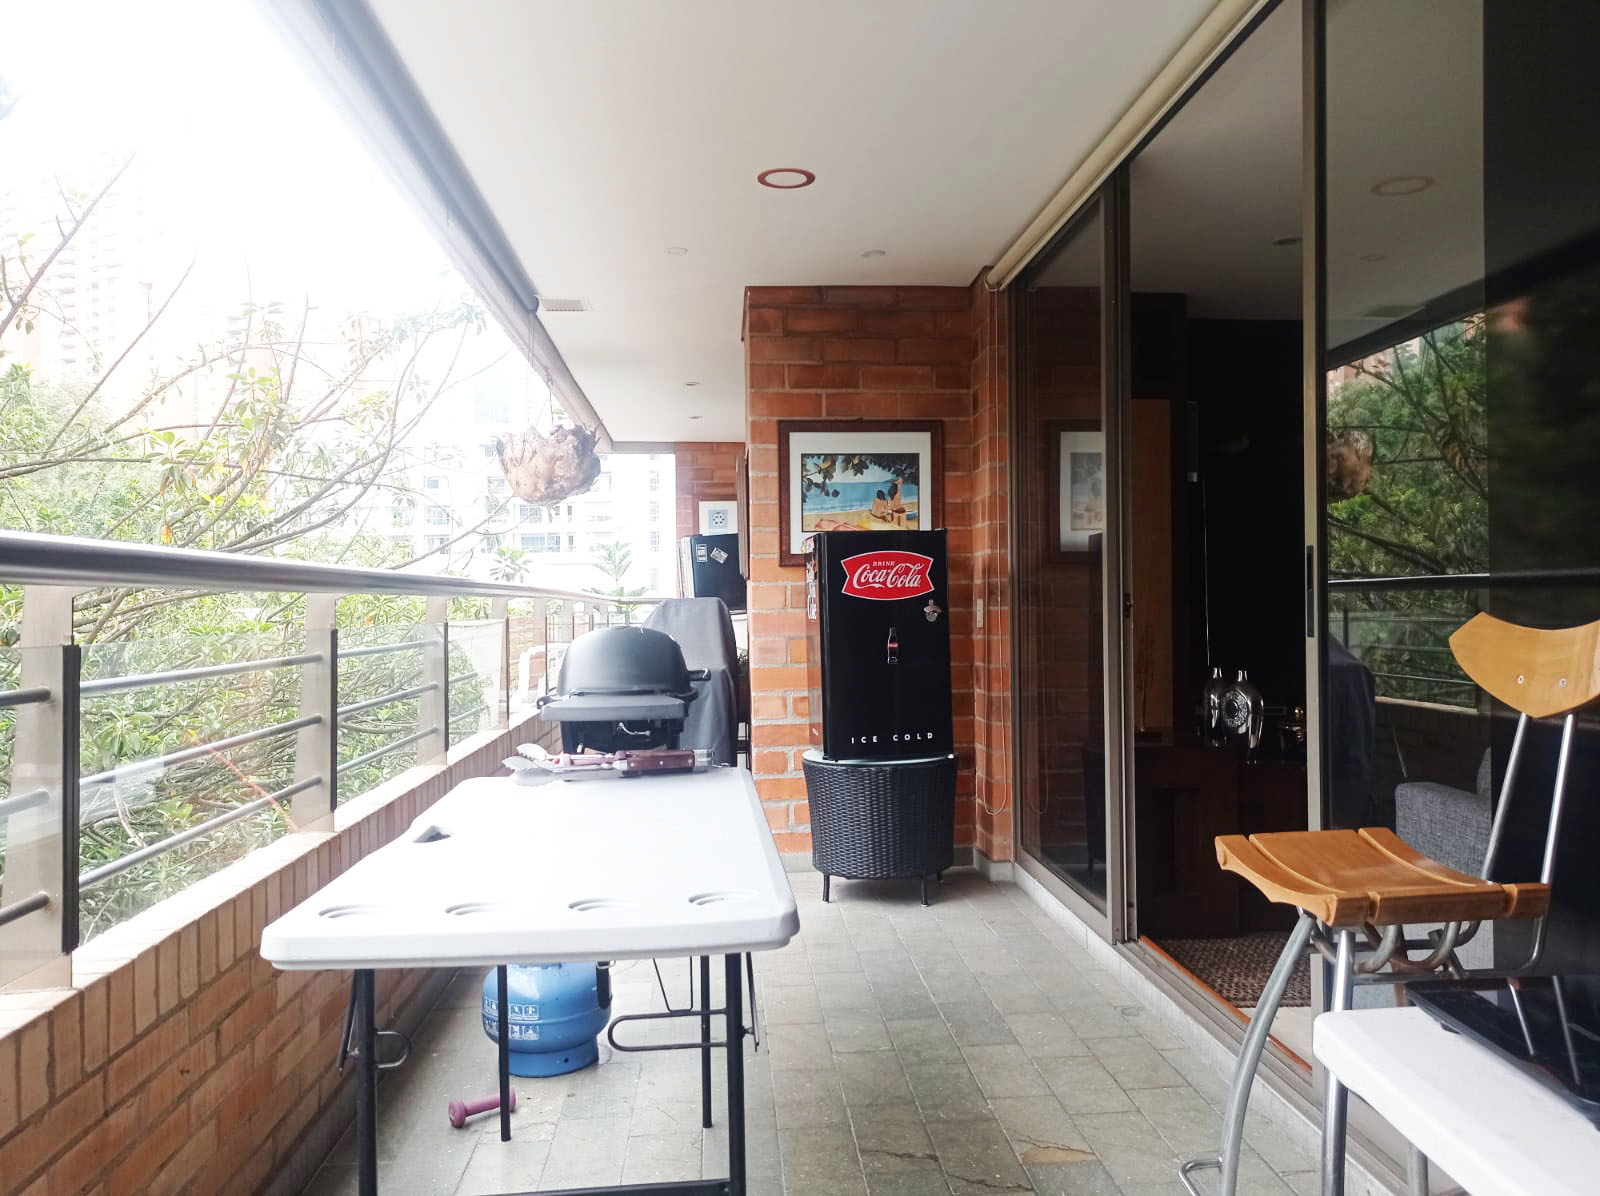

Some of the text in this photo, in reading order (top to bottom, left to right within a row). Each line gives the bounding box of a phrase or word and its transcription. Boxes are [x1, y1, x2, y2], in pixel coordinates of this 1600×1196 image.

[852, 563, 924, 589] Coca-Cola
[851, 732, 933, 744] ICE COLD
